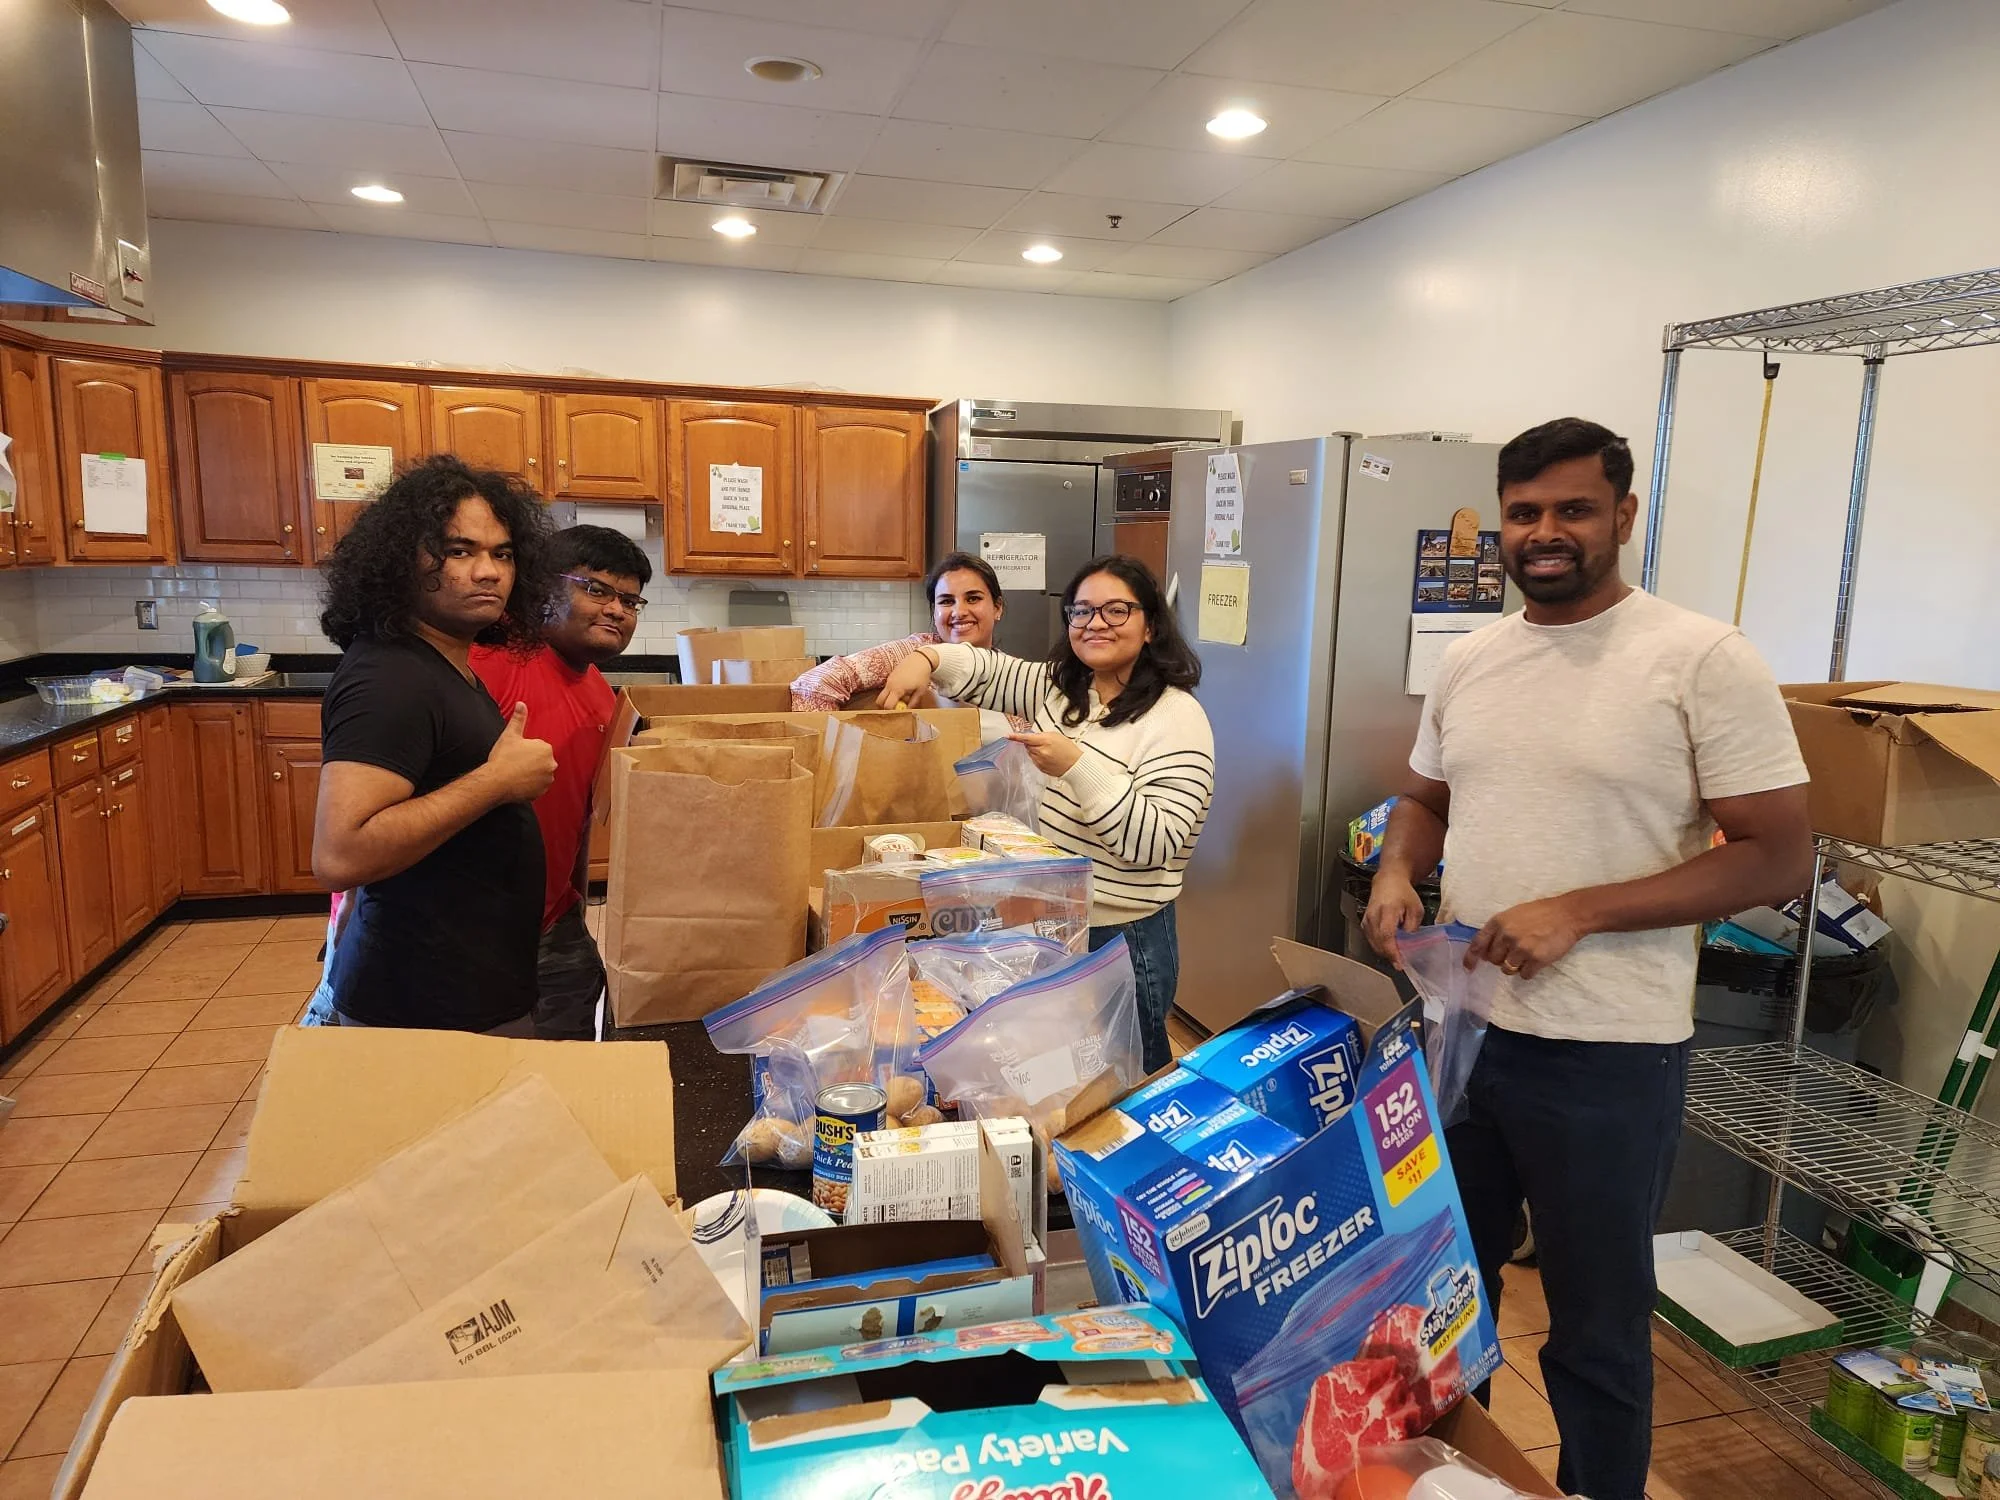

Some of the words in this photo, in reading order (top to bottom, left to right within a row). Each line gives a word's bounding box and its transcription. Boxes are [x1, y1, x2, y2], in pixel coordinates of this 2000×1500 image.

[986, 553, 1033, 561] REFRIGERATOR
[1207, 593, 1238, 608] FREEZER
[892, 914, 918, 925] NISSIN
[1240, 1026, 1311, 1067] Ziploc
[1148, 1106, 1190, 1133] Zip
[1374, 1082, 1418, 1133] 152
[815, 1118, 854, 1141] BUSH'S
[1382, 1108, 1422, 1149] GALLON
[1396, 1128, 1415, 1148] BAGS
[813, 1150, 833, 1166] Chick
[1396, 1148, 1427, 1180] SAVE
[1408, 1169, 1422, 1184] $11
[889, 1204, 897, 1218] 230
[1066, 1181, 1118, 1243] Ziploc
[1120, 1208, 1156, 1257] 152
[1199, 1195, 1319, 1299] Ziploc
[1254, 1206, 1375, 1306] FREEZER
[479, 1299, 516, 1338] AJM
[1433, 1333, 1452, 1355] EASY
[1450, 1305, 1476, 1336] FILLING
[457, 1351, 474, 1367] 1/8
[475, 1341, 497, 1357] BBL
[978, 1427, 1130, 1468] Variety
